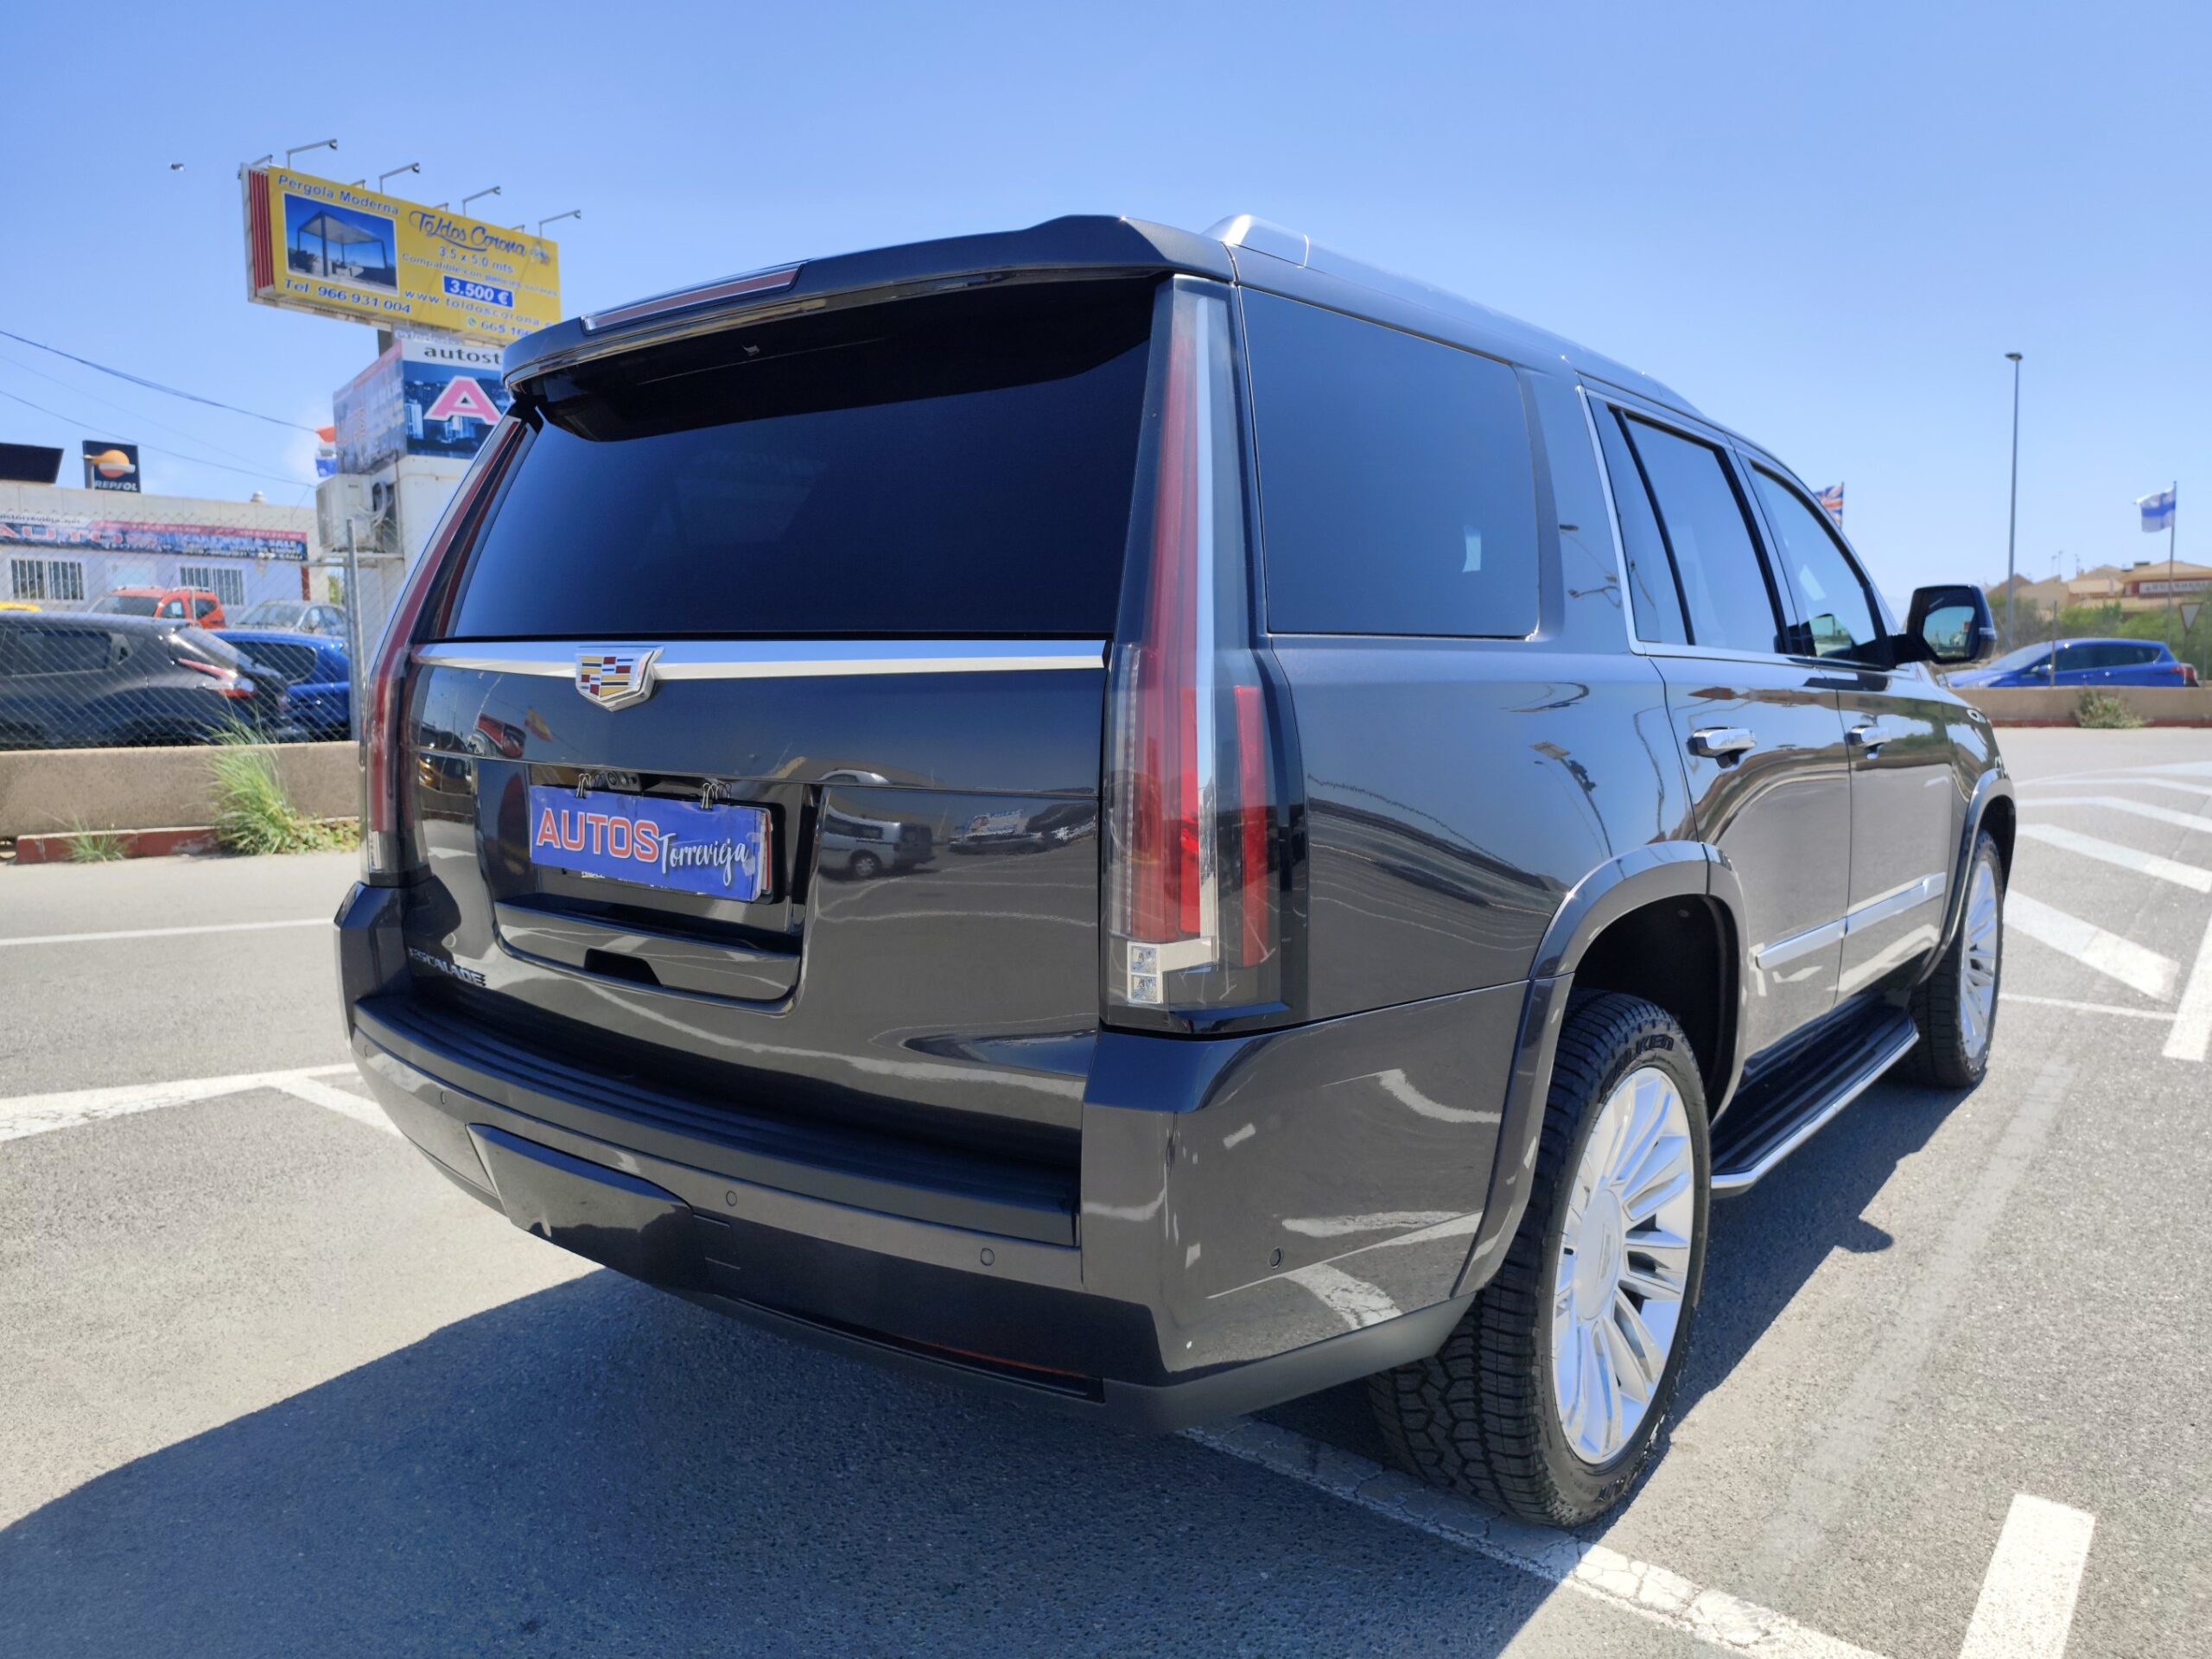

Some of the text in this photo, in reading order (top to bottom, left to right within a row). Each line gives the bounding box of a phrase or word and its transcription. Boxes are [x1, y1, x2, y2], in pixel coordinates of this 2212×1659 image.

[278, 174, 399, 215] Pergola Moderna
[410, 210, 526, 257] Toldos Corona
[318, 286, 347, 301] 966
[351, 293, 378, 308] 931
[384, 300, 410, 314] 004
[449, 279, 510, 306] 3.500 €
[94, 480, 137, 492] REPSOL
[535, 807, 749, 887] AUTOS Torrevieja
[408, 947, 486, 987] ESCALADE
